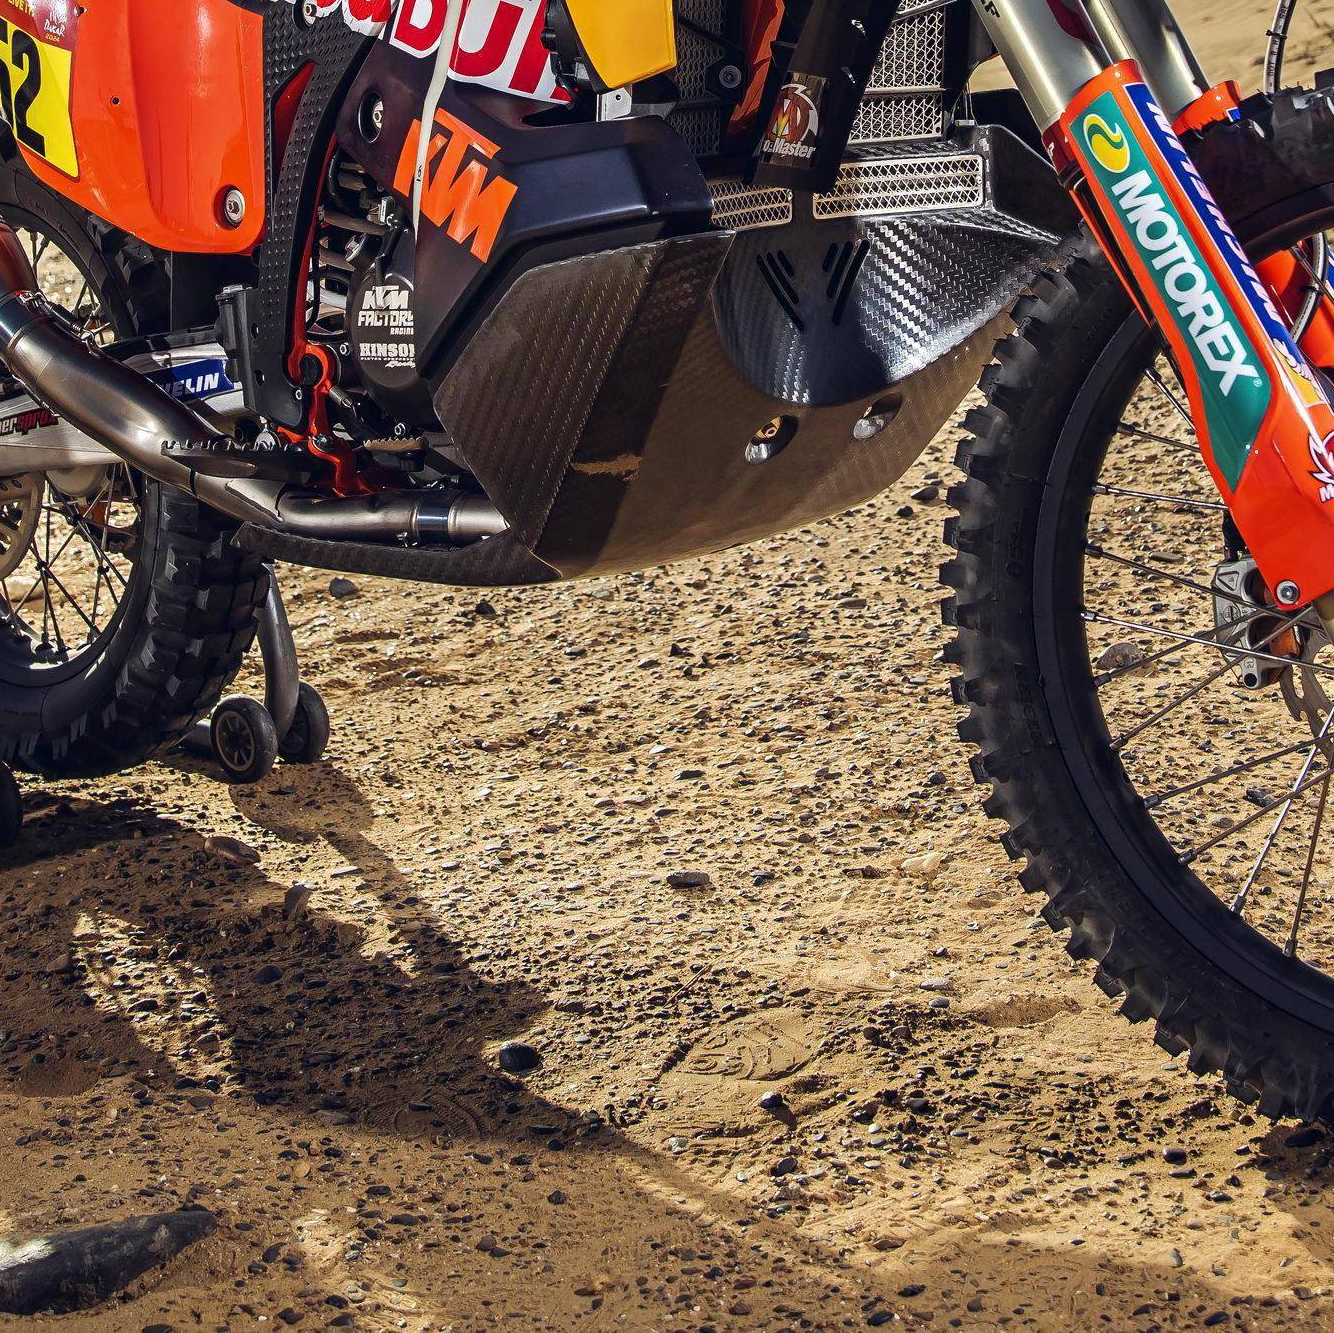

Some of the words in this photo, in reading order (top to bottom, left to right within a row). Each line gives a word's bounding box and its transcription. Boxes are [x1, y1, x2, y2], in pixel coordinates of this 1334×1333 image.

[43, 20, 66, 38] DAKAR
[44, 33, 61, 43] 2024
[393, 108, 519, 264] KTM
[1112, 170, 1260, 397] MOTOREX
[361, 285, 409, 310] KTM
